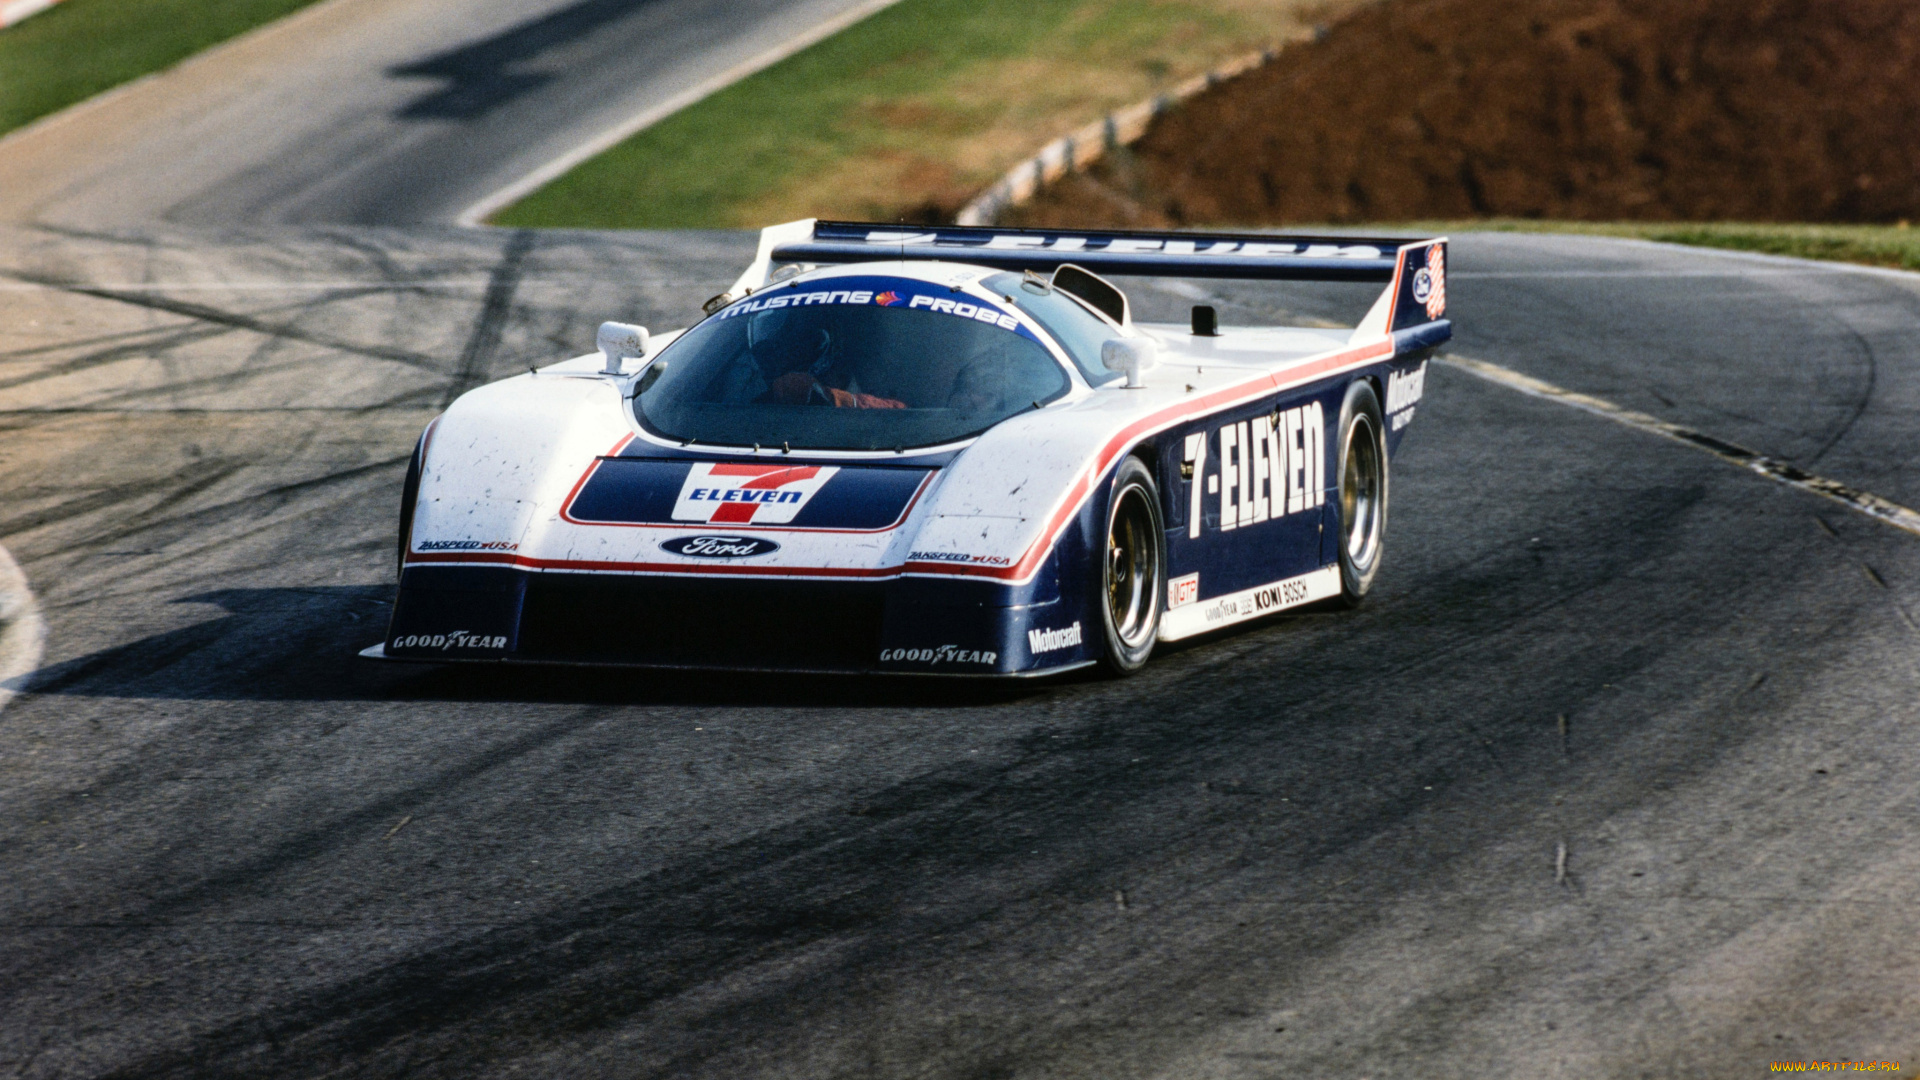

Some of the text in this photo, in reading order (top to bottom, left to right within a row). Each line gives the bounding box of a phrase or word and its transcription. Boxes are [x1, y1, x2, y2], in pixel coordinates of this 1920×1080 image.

[721, 290, 1020, 331] MUSTANG PROBE
[708, 463, 822, 523] 7
[417, 541, 519, 551] ZAKSPEED USA
[681, 536, 759, 555] Ford
[907, 551, 1011, 565] ZAKSPEED USA
[1179, 580, 1197, 602] GTP
[1253, 587, 1283, 611] KONI
[1283, 578, 1309, 604] BOSCH
[1028, 621, 1083, 655] Motorcraft
